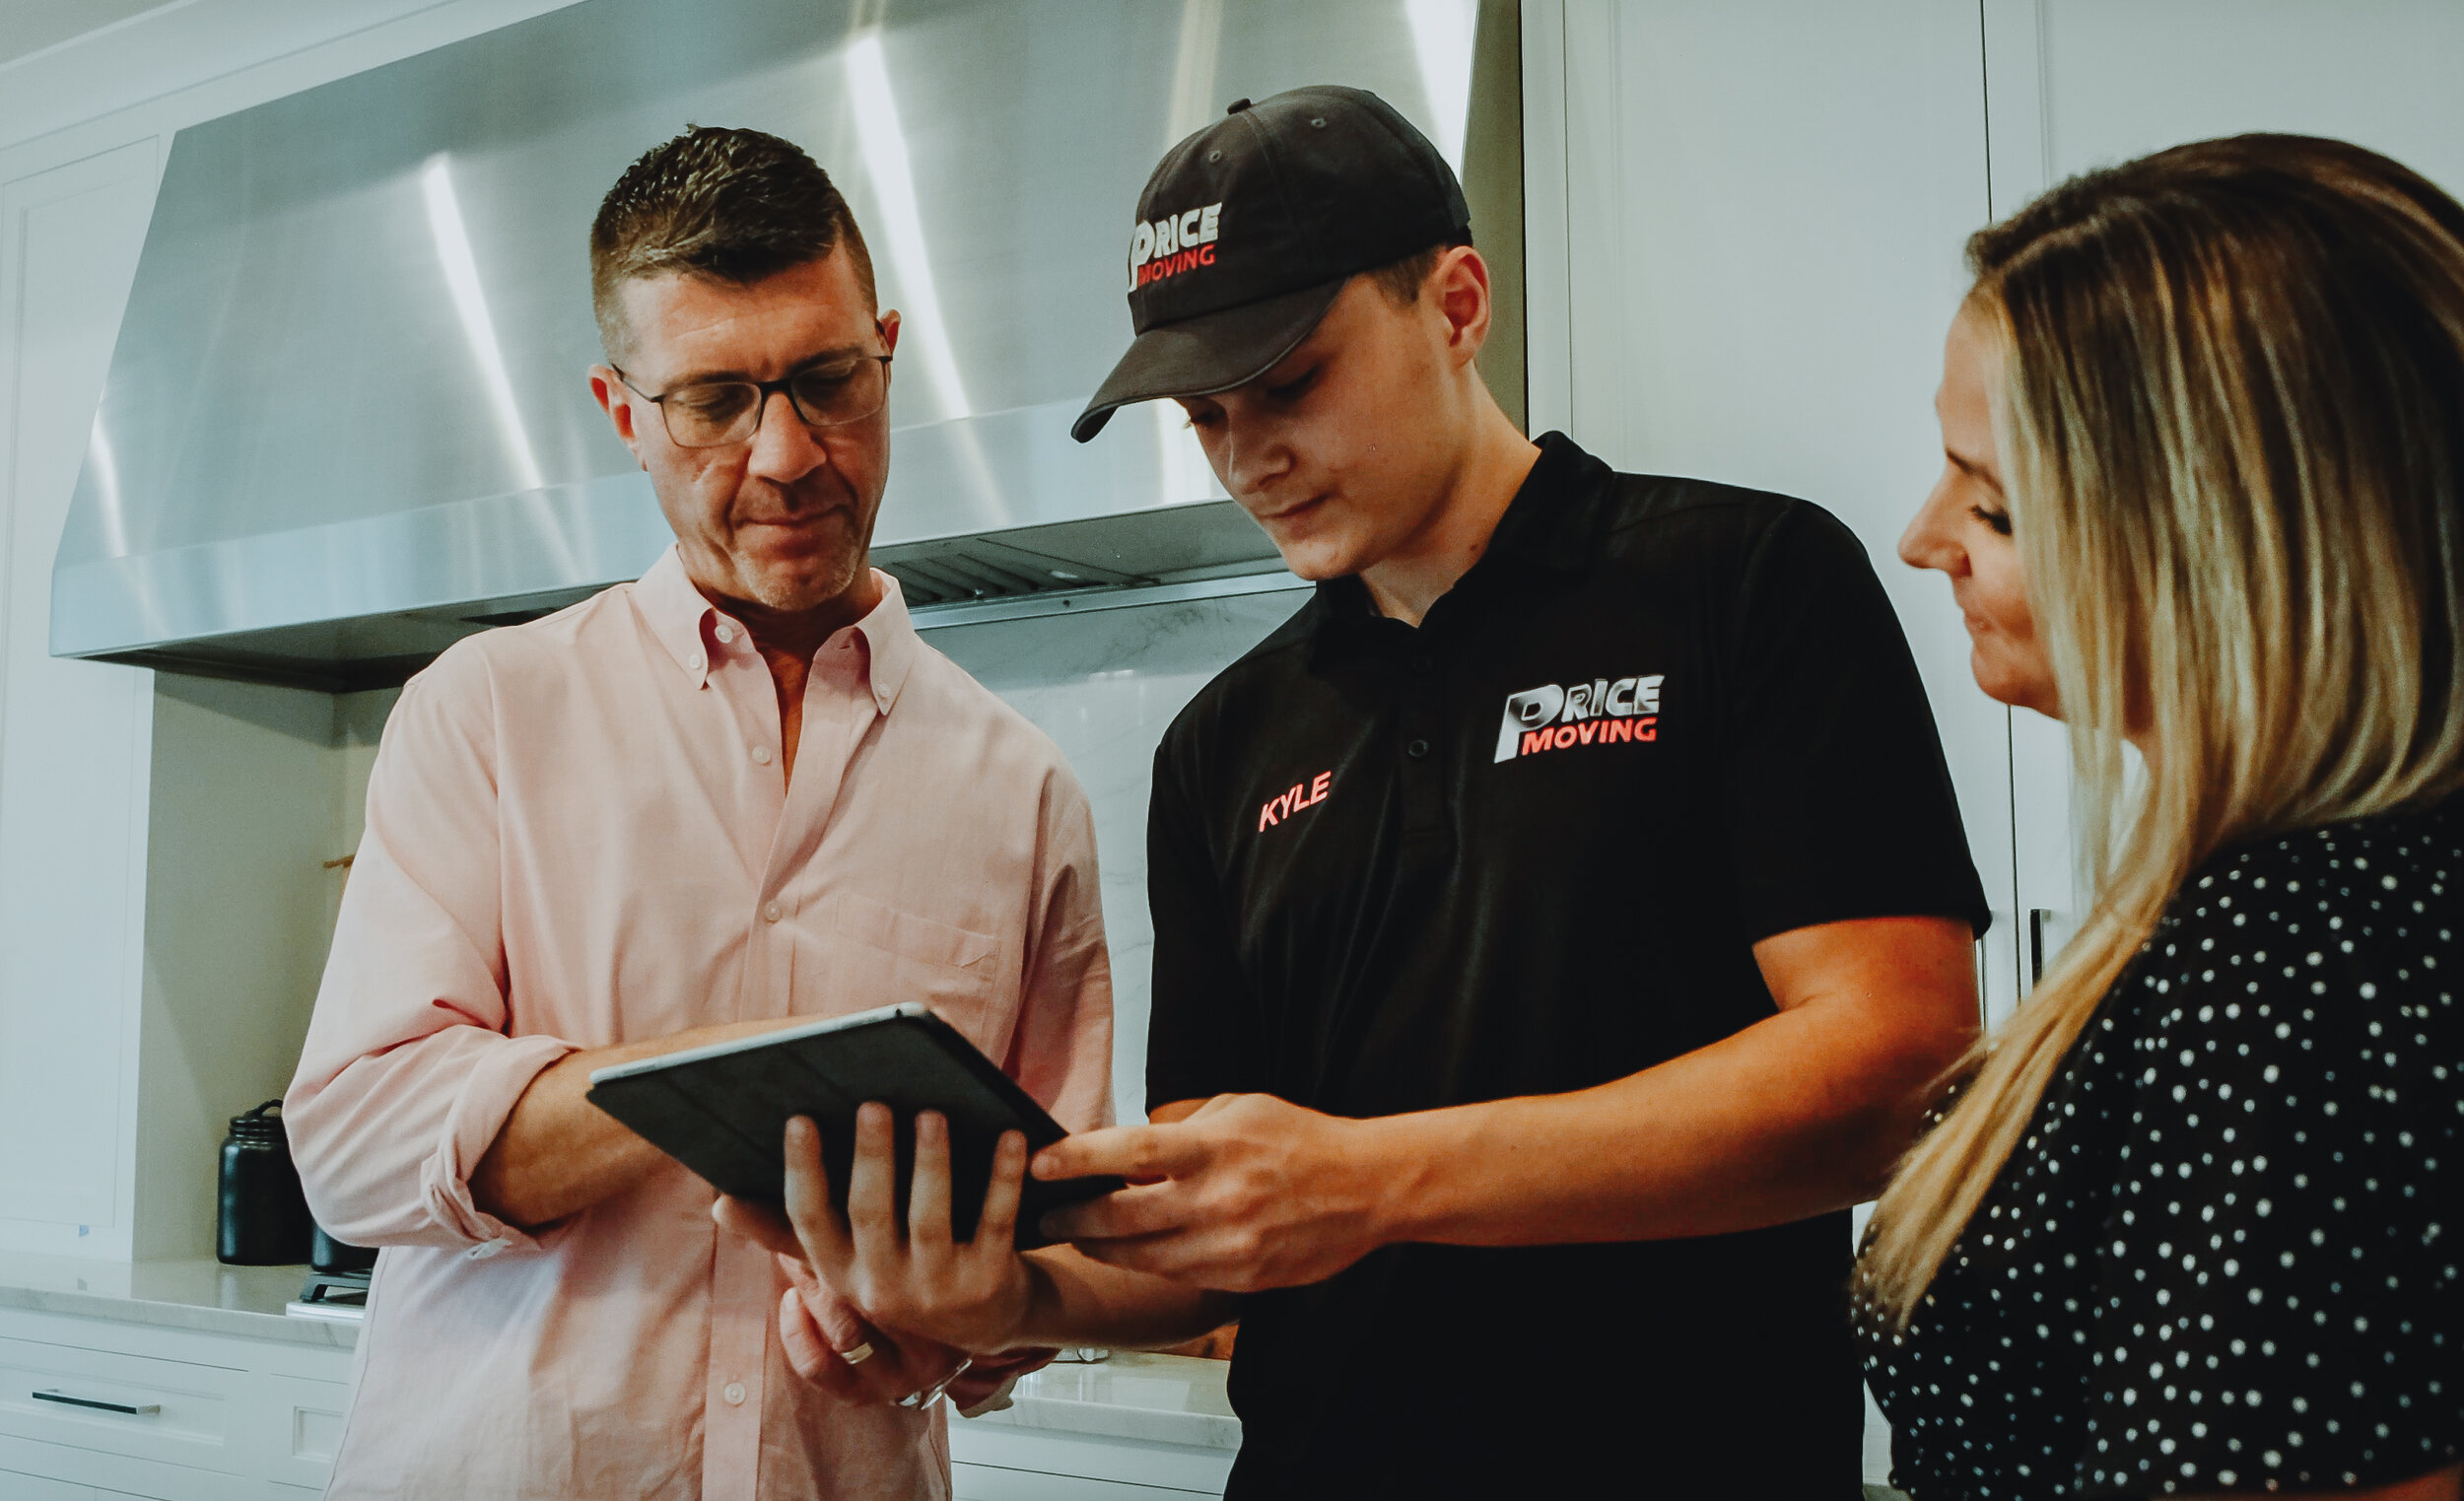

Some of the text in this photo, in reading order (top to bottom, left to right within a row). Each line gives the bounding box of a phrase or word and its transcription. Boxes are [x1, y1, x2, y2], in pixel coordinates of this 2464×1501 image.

[1128, 201, 1223, 293] PRICE
[1137, 243, 1216, 287] MOVING
[1493, 674, 1666, 764] PRICE
[1521, 716, 1659, 756] MOVING
[1259, 770, 1332, 833] KYLE
